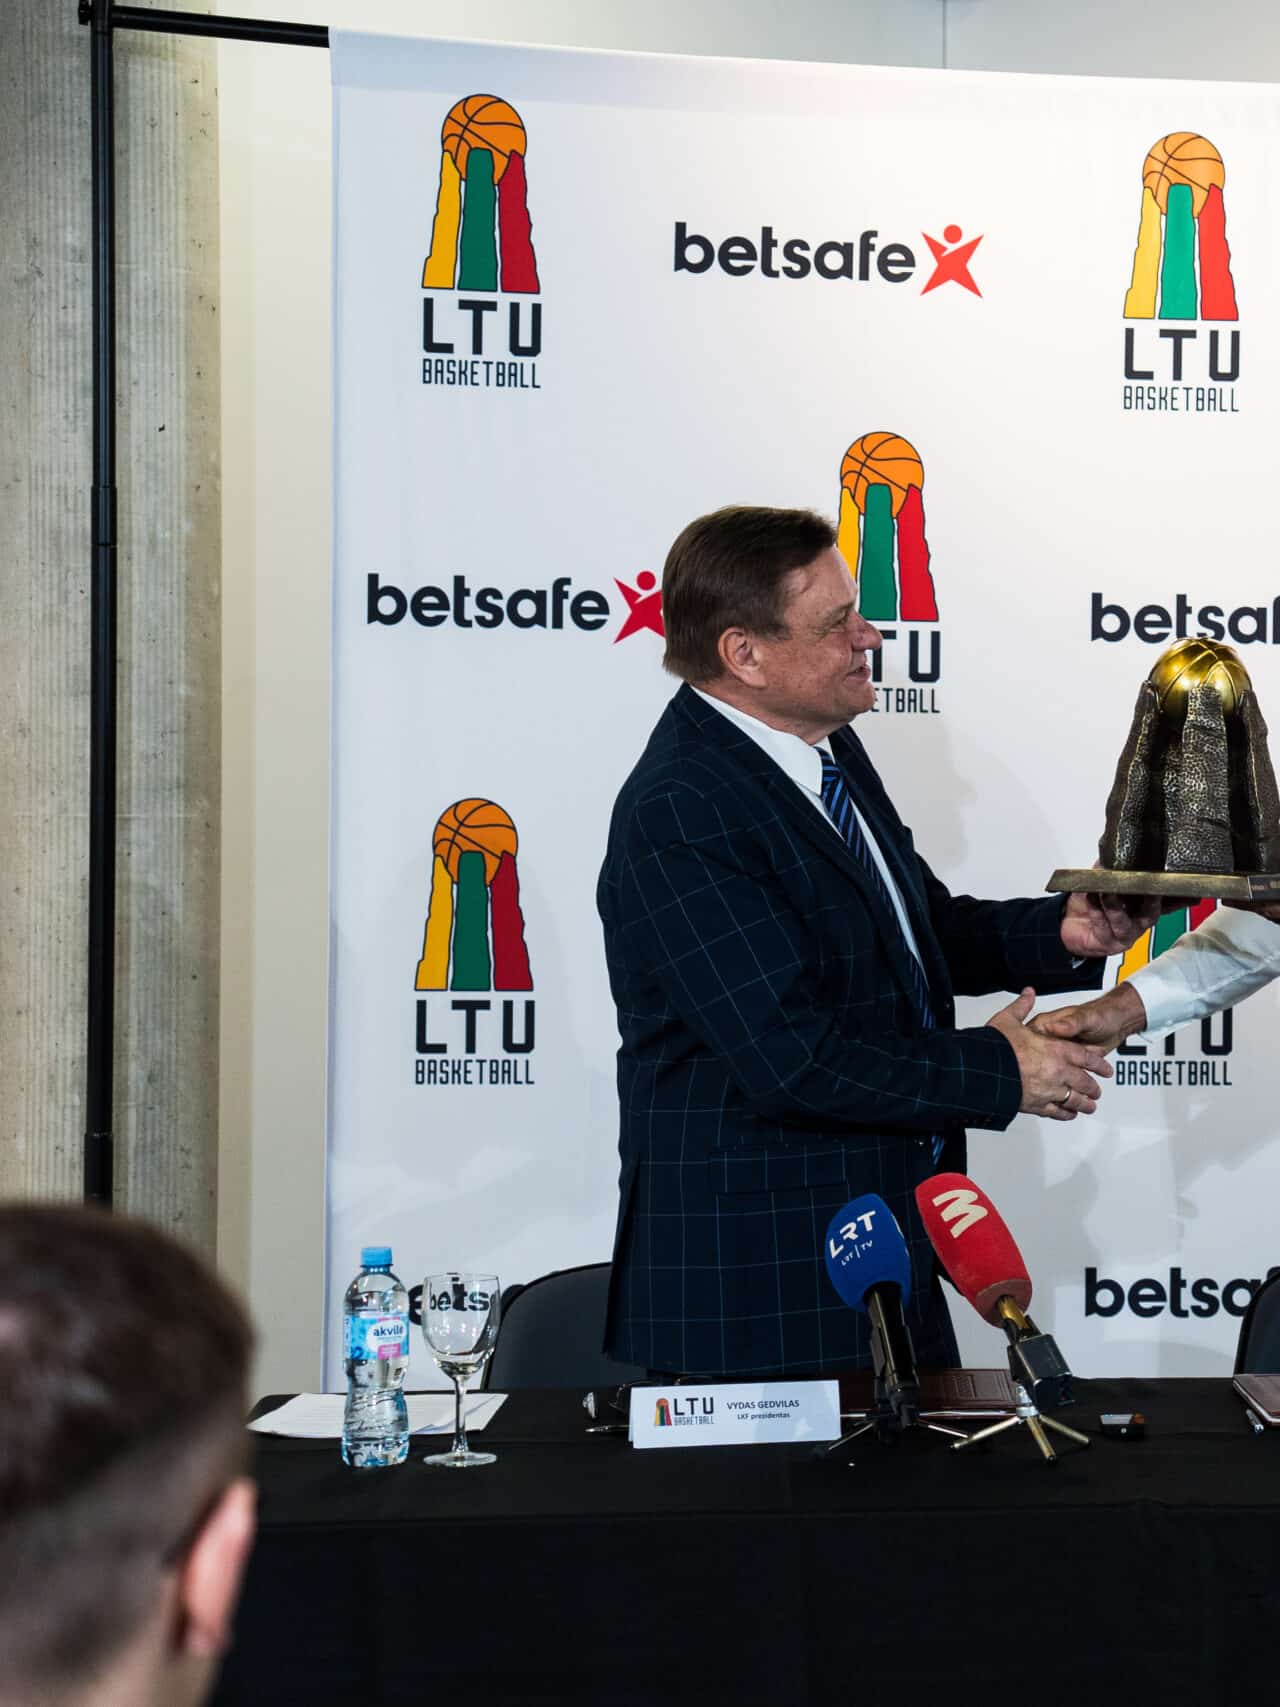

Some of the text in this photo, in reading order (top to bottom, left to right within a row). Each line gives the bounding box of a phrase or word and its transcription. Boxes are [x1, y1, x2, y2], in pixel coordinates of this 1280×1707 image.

[673, 222, 916, 283] betsafe
[422, 297, 541, 357] LTU
[422, 358, 541, 389] BASKETBALL
[1124, 327, 1240, 381] LTU
[1123, 385, 1239, 412] BASKETBALL
[366, 573, 611, 632] betsafe
[416, 1000, 535, 1054] LTU
[415, 1059, 535, 1086] BASKETBALL
[1115, 1060, 1233, 1087] BASKETBALL
[828, 1210, 877, 1259] LRT
[674, 1396, 715, 1416] LTU
[726, 1399, 800, 1410] VYDAS GEDVILAS
